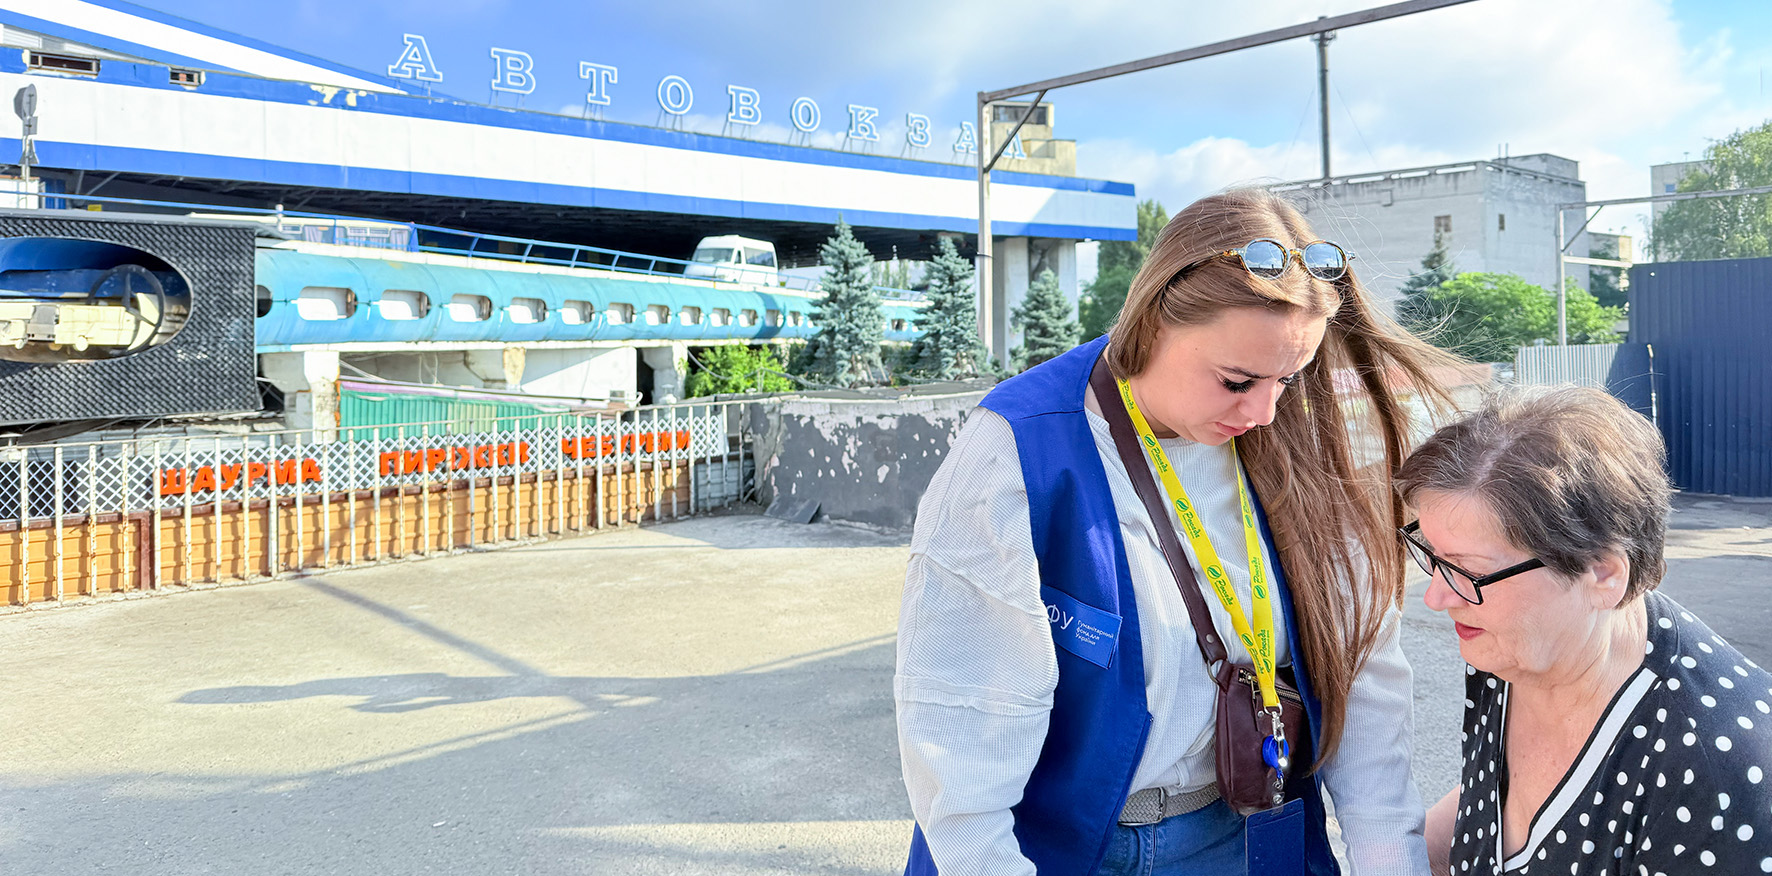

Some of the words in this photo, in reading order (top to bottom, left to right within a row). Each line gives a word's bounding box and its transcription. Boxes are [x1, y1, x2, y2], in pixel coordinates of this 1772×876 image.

[388, 33, 1027, 160] АВТОВОКЗАЛ
[159, 458, 322, 495] ШАУРМА
[1044, 603, 1074, 630] ФУ
